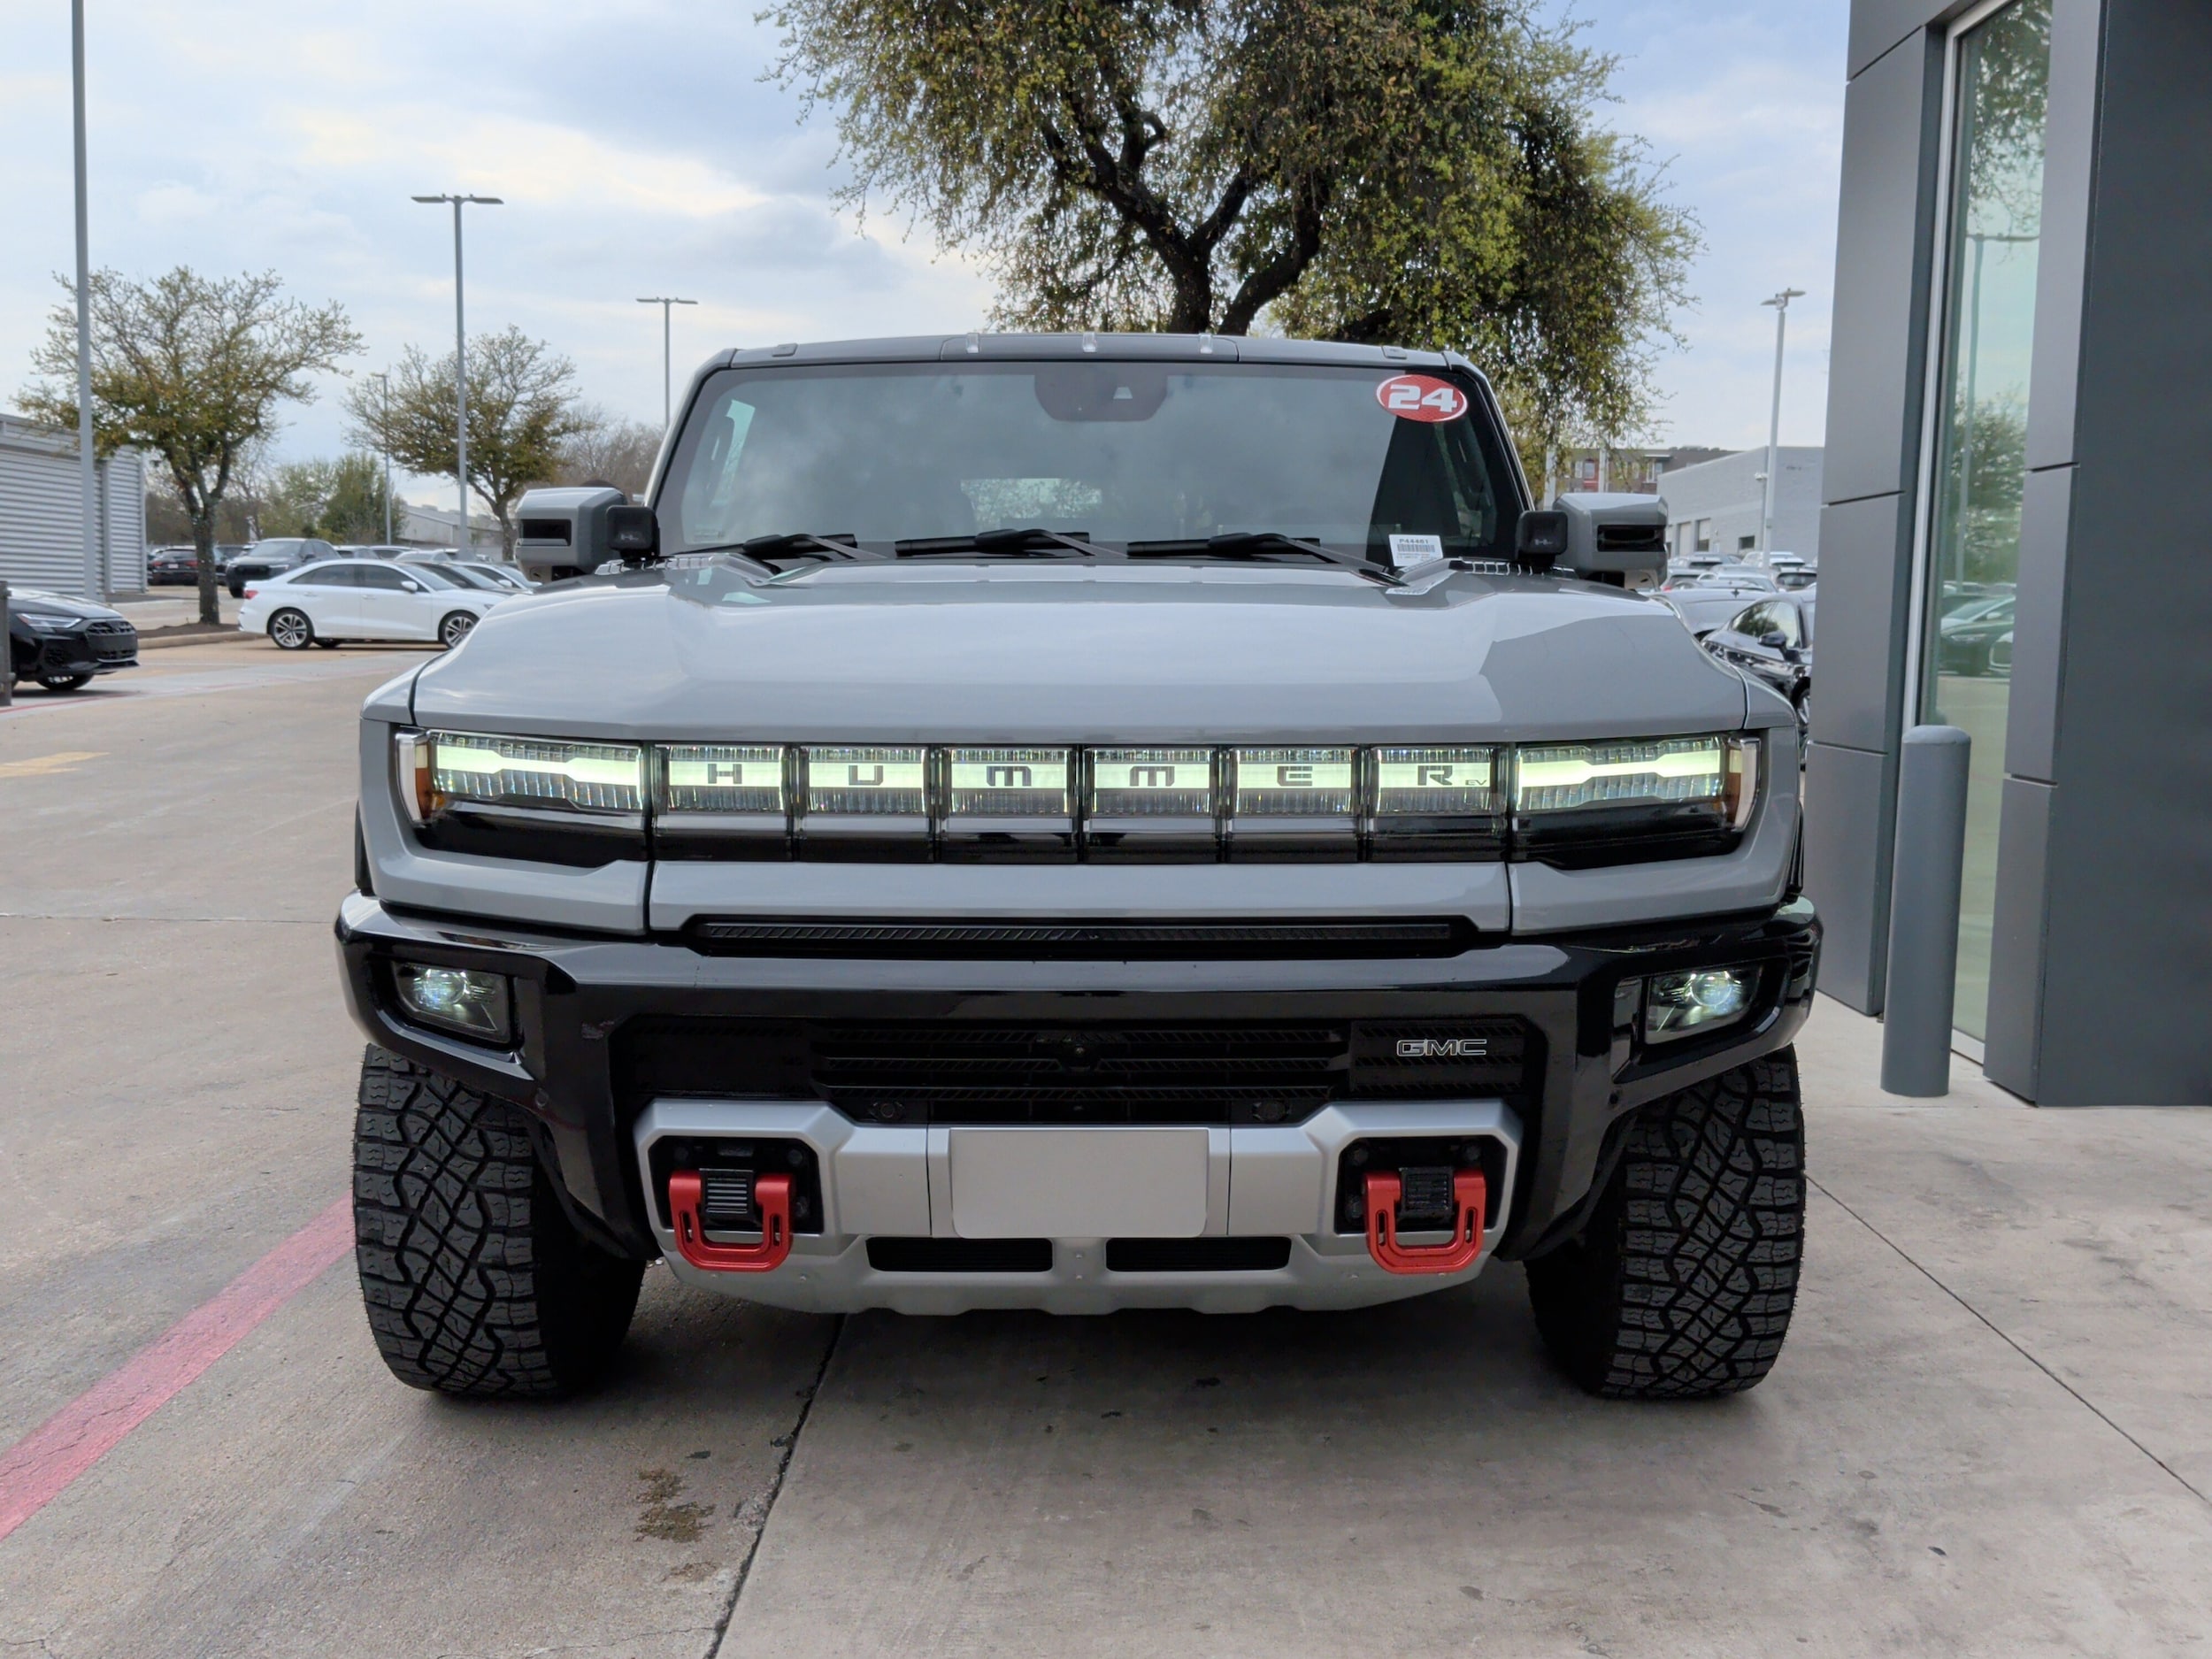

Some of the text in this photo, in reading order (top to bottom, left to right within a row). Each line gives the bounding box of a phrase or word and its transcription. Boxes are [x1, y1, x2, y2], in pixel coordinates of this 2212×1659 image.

[1388, 384, 1458, 413] 24
[707, 763, 1453, 786] HUMMER
[1396, 1039, 1487, 1057] GMC
